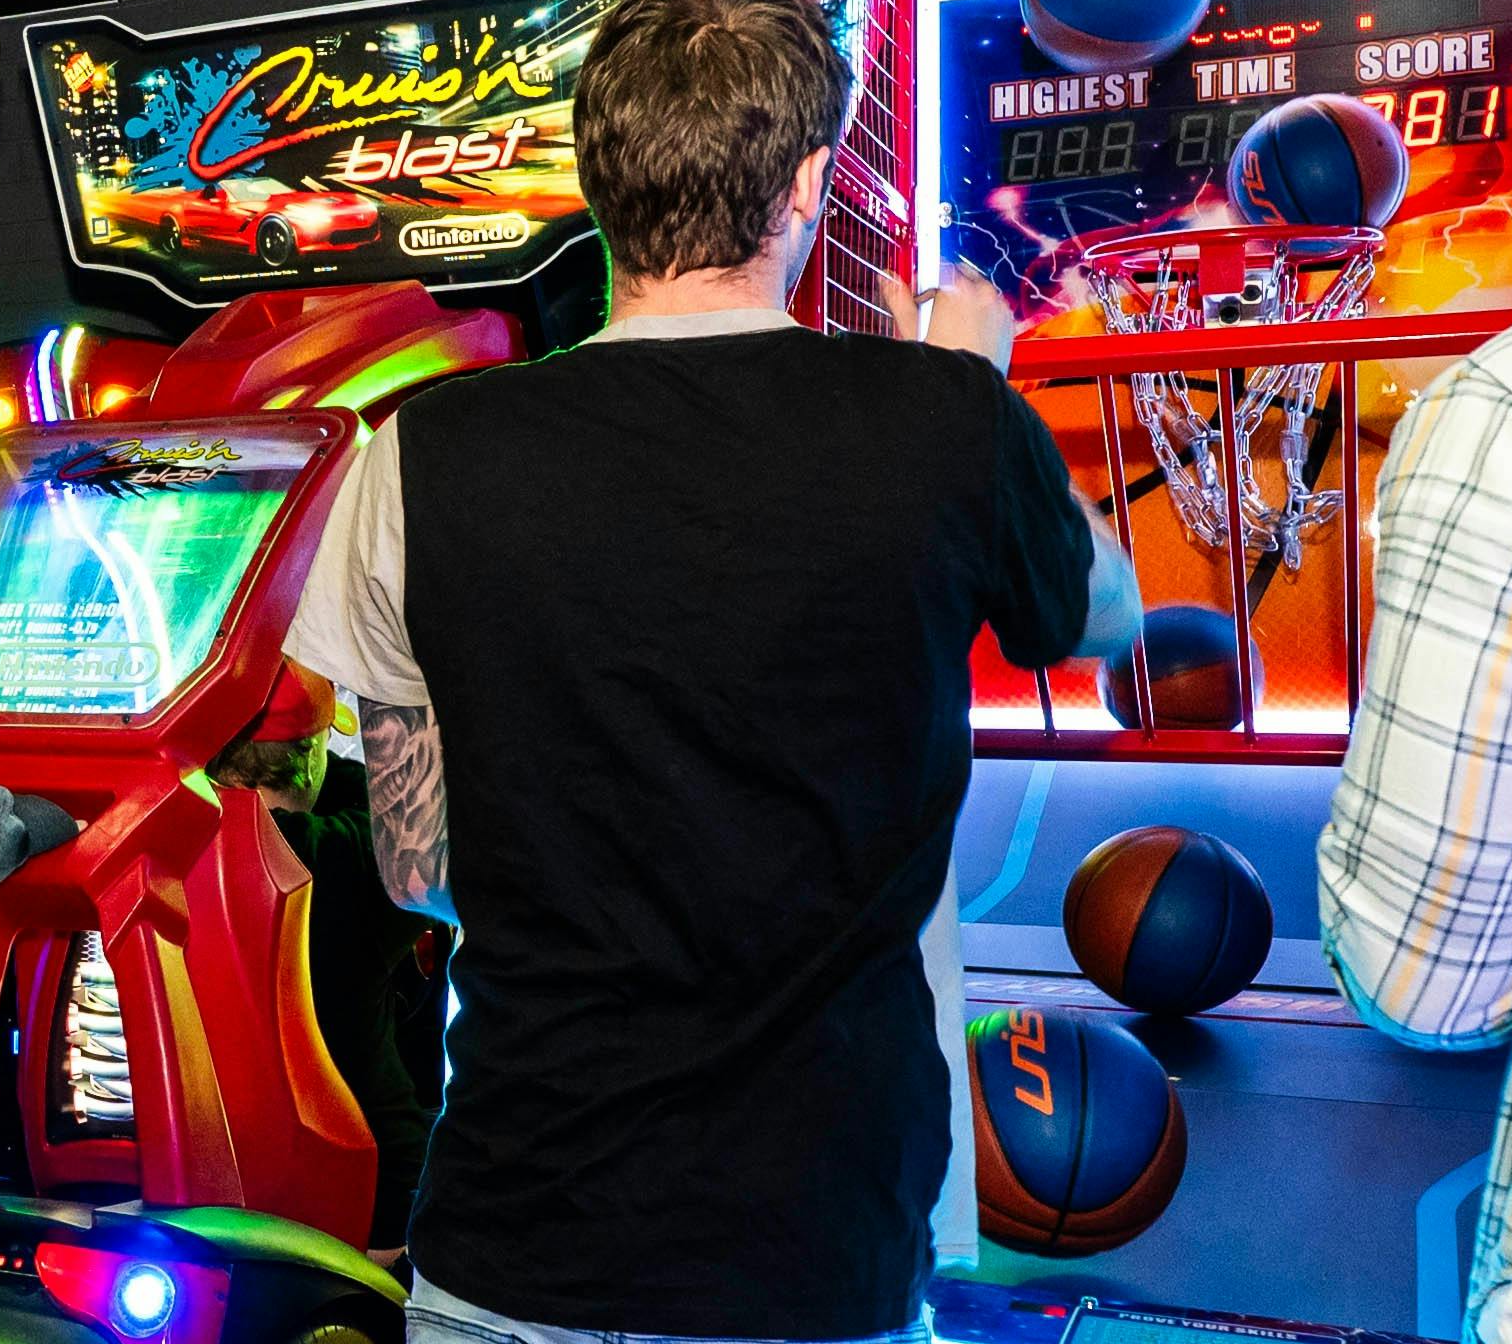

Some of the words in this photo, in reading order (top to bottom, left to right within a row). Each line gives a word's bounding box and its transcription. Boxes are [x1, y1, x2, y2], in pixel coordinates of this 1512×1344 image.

[1195, 53, 1296, 101] TIME
[1355, 29, 1494, 84] SCORE
[992, 69, 1150, 122] HIGHEST
[343, 116, 537, 184] blast
[410, 224, 517, 250] Nintendo
[131, 464, 226, 484] blast
[1119, 1312, 1176, 1326] PROVE
[1181, 1320, 1230, 1333] YOUR
[1235, 1326, 1299, 1341] SKILLS
